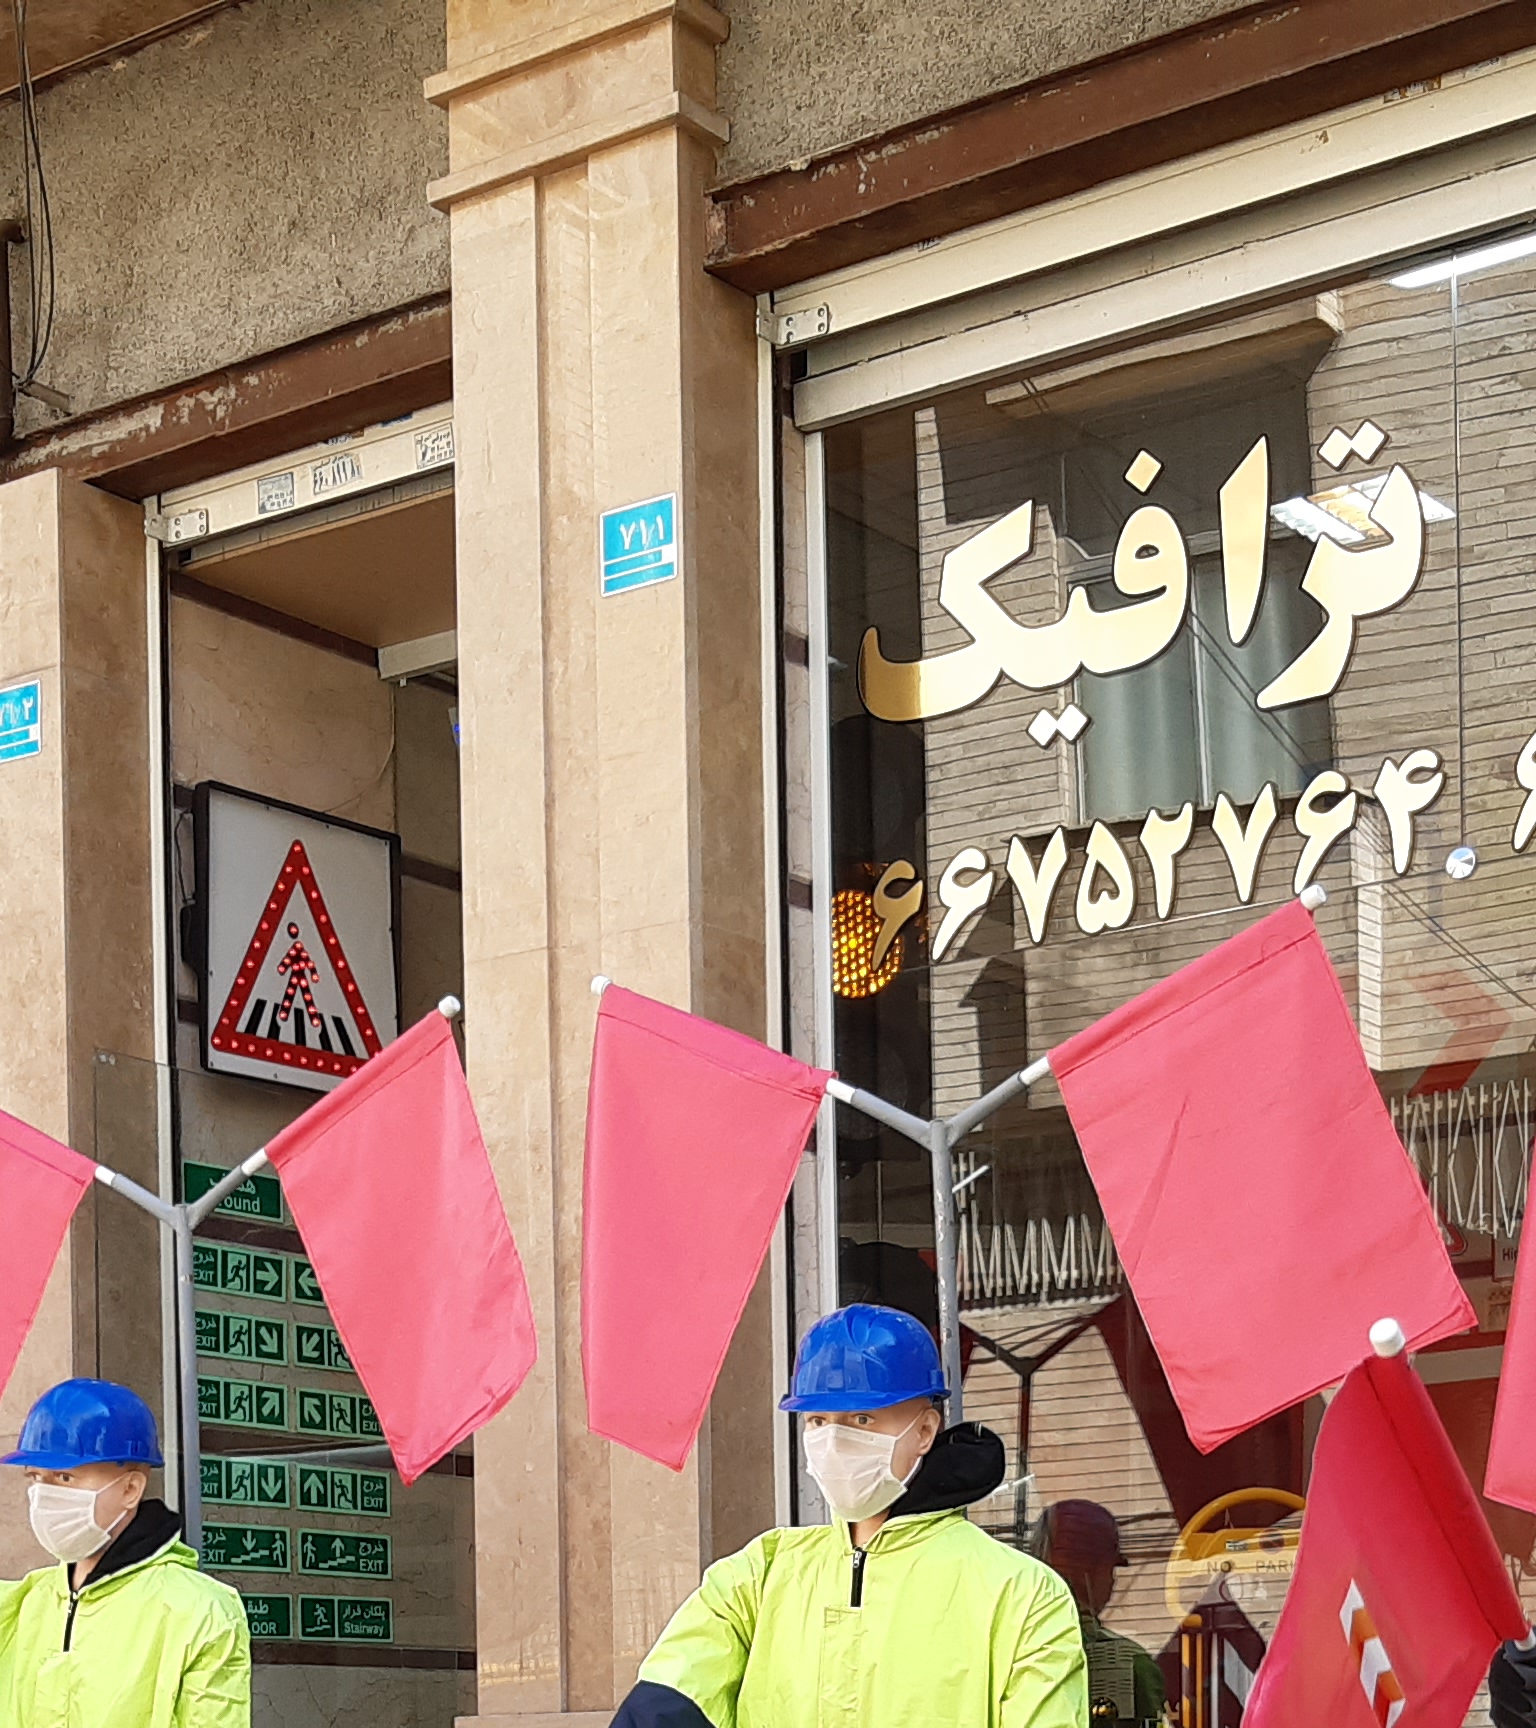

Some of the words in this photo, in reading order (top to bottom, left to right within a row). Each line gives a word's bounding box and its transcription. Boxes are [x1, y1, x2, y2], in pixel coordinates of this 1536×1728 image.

[857, 419, 1426, 748] ترافیک
[869, 748, 1446, 971] ۶۶۷۵۲۷۶۴
[219, 1196, 261, 1213] ound
[201, 1482, 219, 1495] XIT
[364, 1497, 384, 1509] EXIT
[359, 1540, 384, 1556] خروج
[360, 1558, 384, 1572] EXIT
[251, 1621, 277, 1635] OOR
[344, 1621, 384, 1637] Stairway
